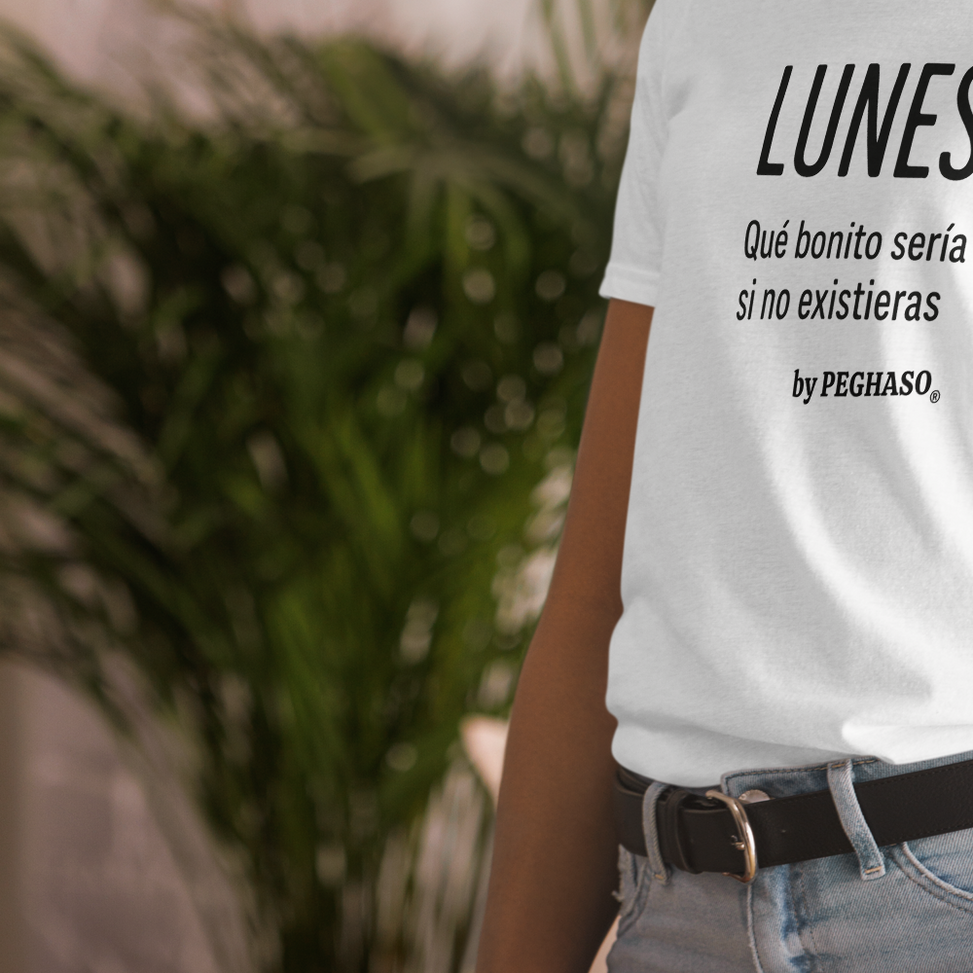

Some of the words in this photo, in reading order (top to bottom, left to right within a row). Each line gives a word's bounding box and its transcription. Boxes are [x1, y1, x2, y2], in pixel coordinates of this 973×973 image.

[744, 219, 790, 262] Qué
[794, 219, 883, 260] bonito
[890, 222, 967, 264] sería
[736, 278, 757, 321] si
[760, 288, 791, 321] no
[797, 278, 941, 322] existieras
[792, 368, 819, 405] by
